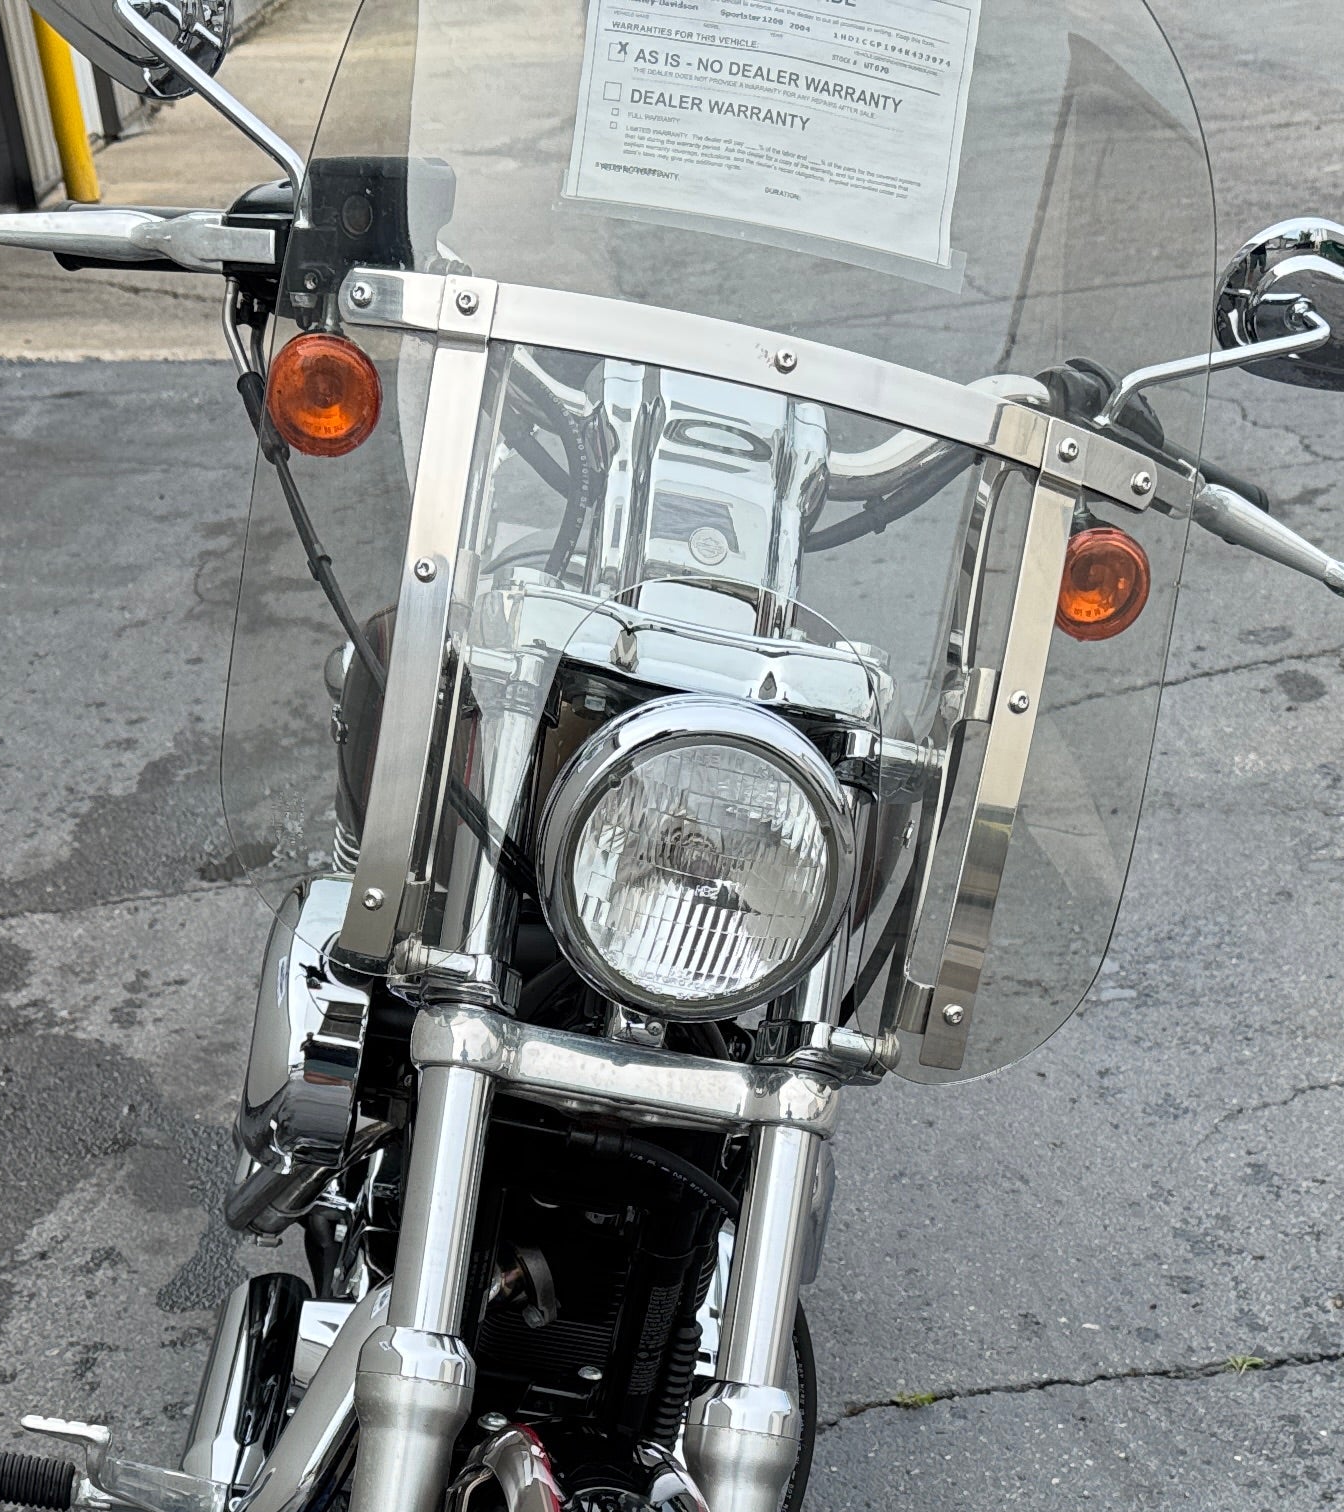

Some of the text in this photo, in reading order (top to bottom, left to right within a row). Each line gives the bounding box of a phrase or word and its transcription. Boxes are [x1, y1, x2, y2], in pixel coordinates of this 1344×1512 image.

[612, 20, 673, 37] WARRANTIES
[674, 29, 693, 40] FOR
[696, 32, 716, 43] THIS
[720, 9, 761, 21] Sportster
[762, 16, 784, 26] 1200
[789, 22, 811, 33] 2004
[634, 48, 659, 65] AS
[664, 52, 681, 68] IS
[697, 57, 723, 74] NO
[729, 61, 800, 88] DEALER
[805, 75, 904, 114] WARRANTY
[630, 88, 810, 131] DEALER WARRANTY
